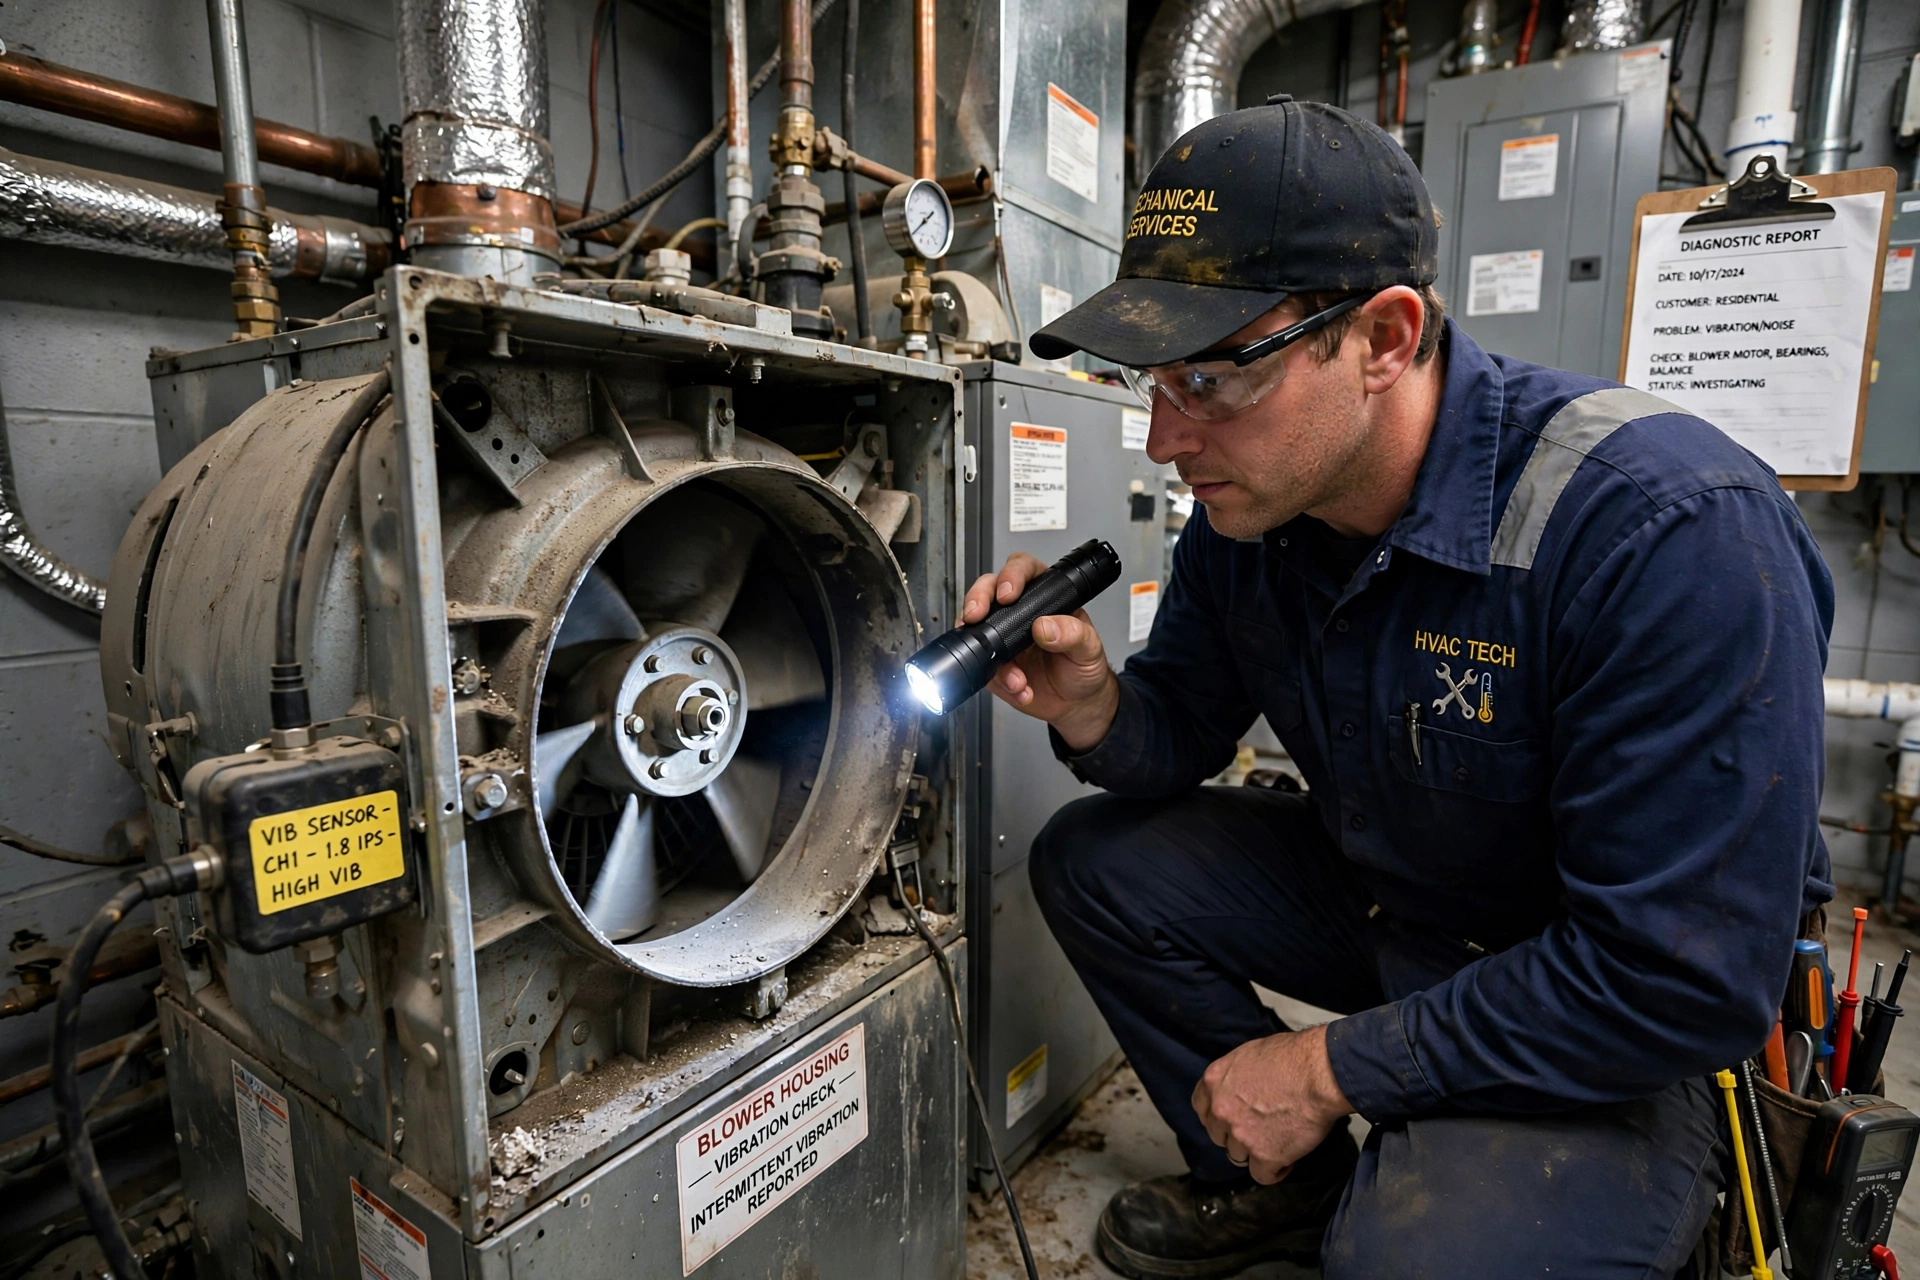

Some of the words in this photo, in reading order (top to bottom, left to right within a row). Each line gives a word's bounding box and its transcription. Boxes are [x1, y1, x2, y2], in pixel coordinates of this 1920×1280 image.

[1132, 189, 1219, 215] ECHANICAL
[1680, 234, 1762, 252] DIAGNOSTIC
[1765, 229, 1821, 244] REPORT
[1658, 272, 1686, 282] DATE:
[1689, 267, 1745, 282] 10/17/2024
[1655, 297, 1712, 310] CUSTOMER:
[1715, 292, 1779, 306] RESIDENTIAL
[1653, 325, 1702, 335] PROBLEM:
[1705, 319, 1796, 333] VIBRATION/NOISE
[1649, 365, 1694, 376] BALANCE
[1650, 353, 1685, 363] CHECK:
[1688, 350, 1730, 362] BLOWER
[1732, 349, 1773, 360] MOTOR,
[1775, 346, 1830, 358] BEARINGS,
[1648, 381, 1687, 391] STATUS:
[1690, 378, 1766, 389] INVESTIGATING
[1414, 630, 1461, 656] HVAC
[1467, 639, 1516, 668] TECH
[261, 822, 297, 846] VIB
[307, 804, 378, 836] SENSOR
[263, 851, 298, 874] CH1
[326, 837, 350, 859] 1.8
[358, 830, 384, 850] IPS
[272, 873, 320, 903] HIGH
[330, 862, 362, 885] VIB
[697, 1091, 776, 1158] BLOWER
[780, 1042, 850, 1103] HOUSING
[714, 1111, 789, 1174] VIBRATION
[792, 1078, 836, 1120] CHECK
[691, 1145, 793, 1235] INTERMITTENT
[795, 1098, 860, 1154] VIBRATION
[748, 1150, 818, 1214] REPORTED
